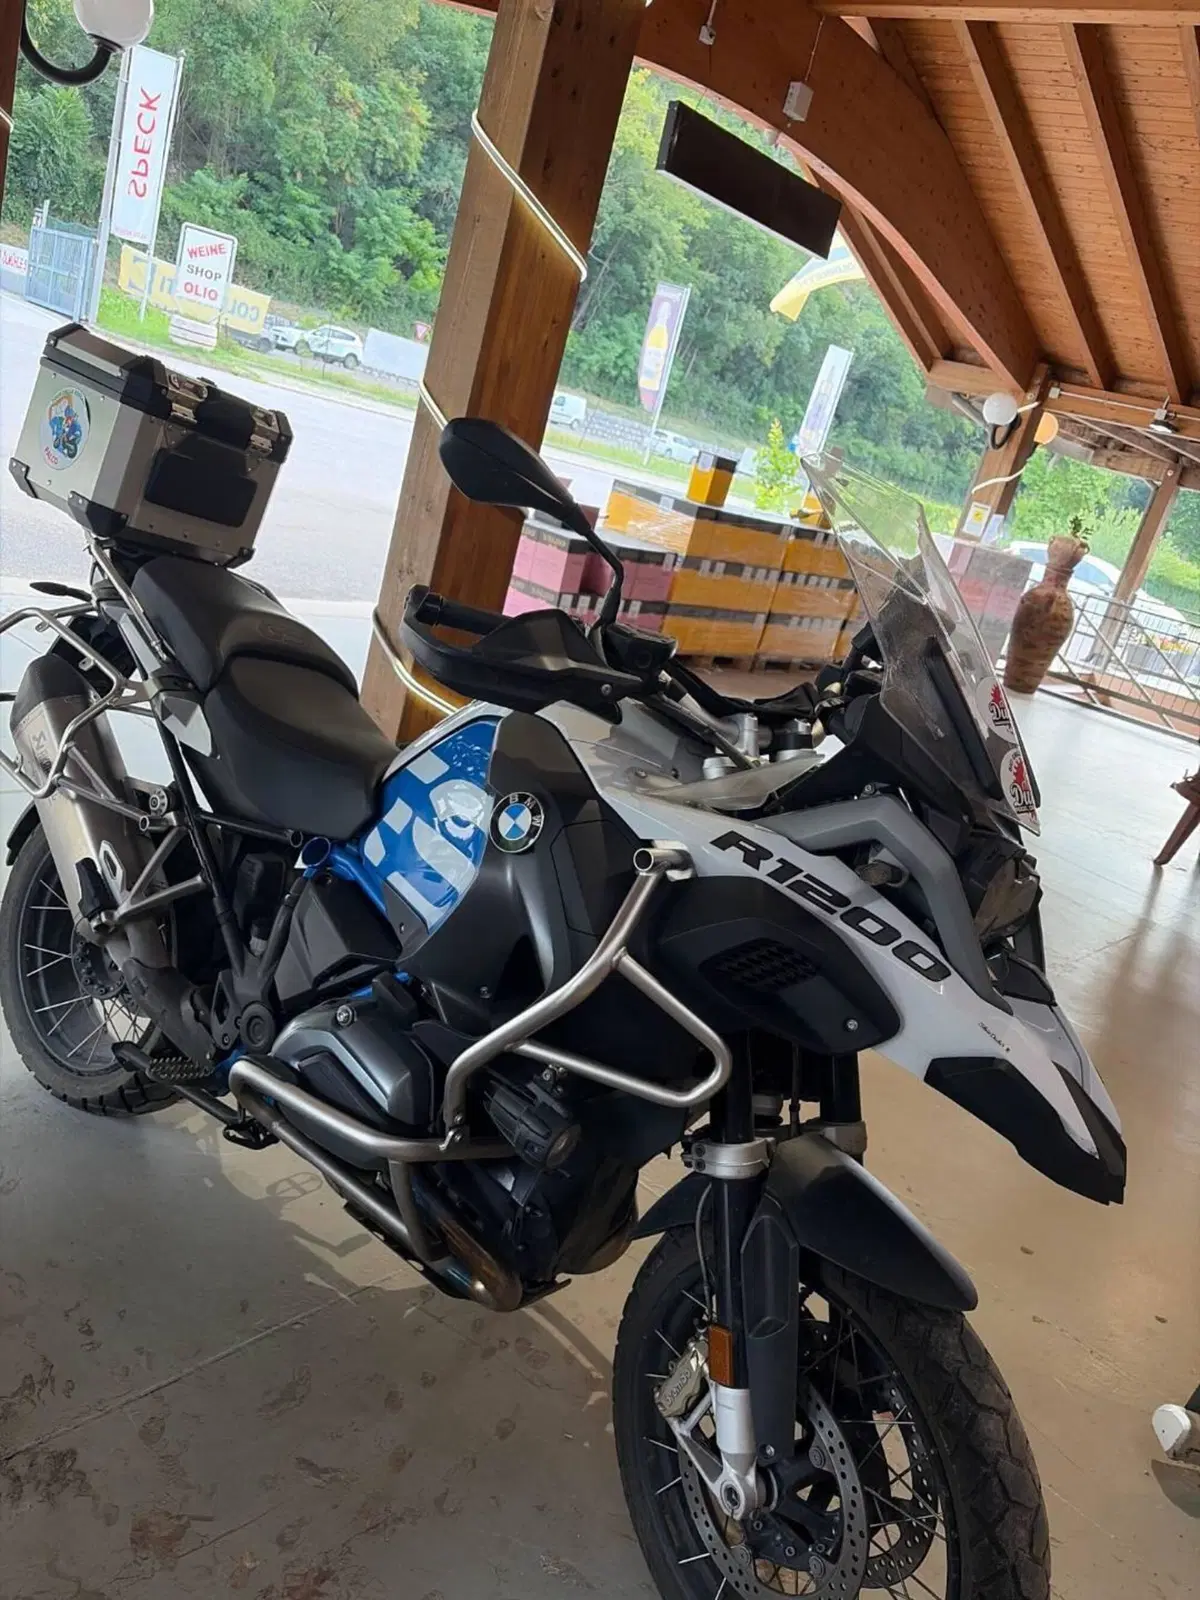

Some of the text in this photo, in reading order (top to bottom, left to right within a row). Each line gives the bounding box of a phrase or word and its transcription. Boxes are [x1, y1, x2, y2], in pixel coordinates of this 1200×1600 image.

[187, 243, 228, 259] WEINE
[186, 263, 222, 282] SHOP
[183, 281, 219, 301] OLIO
[509, 794, 542, 827] BMW
[709, 830, 952, 982] R1200
